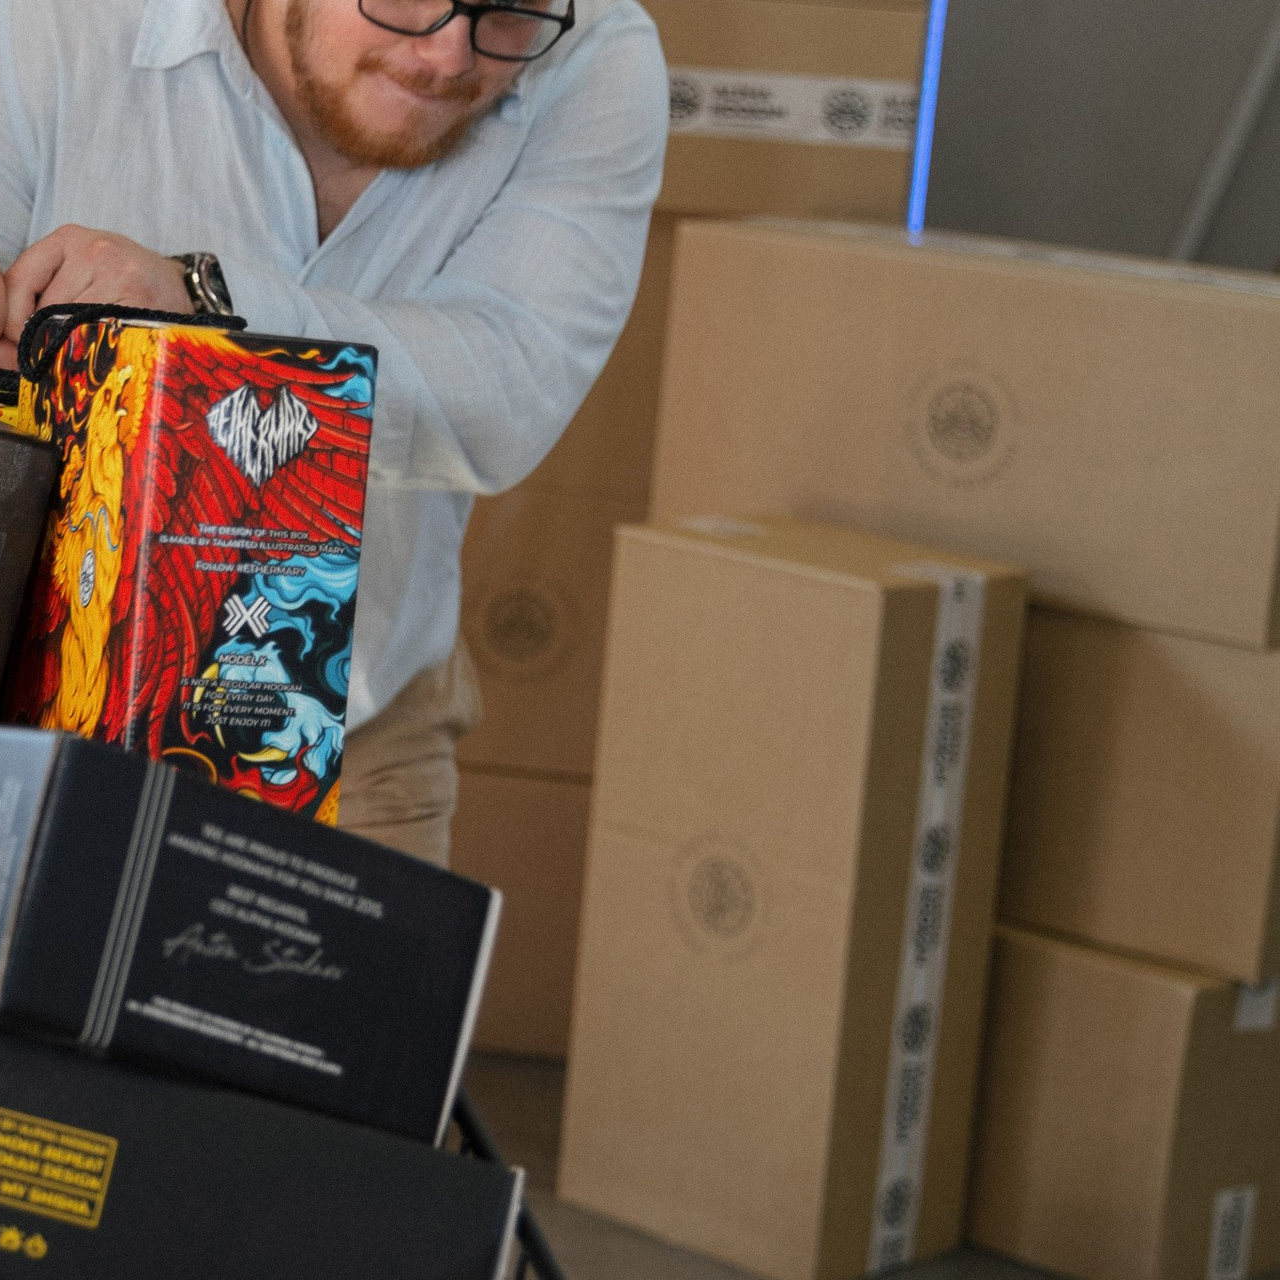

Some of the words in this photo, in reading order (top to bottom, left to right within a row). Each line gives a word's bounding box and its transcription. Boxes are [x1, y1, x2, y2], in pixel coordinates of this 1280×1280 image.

[199, 523, 218, 533] THE
[220, 526, 253, 536] DESIGN
[255, 528, 267, 537] OF
[270, 530, 289, 539] THIS
[291, 531, 310, 540] BOX
[169, 535, 197, 545] MADE
[260, 541, 317, 552] ILLUSTRATOR
[320, 542, 345, 554] MARY
[195, 560, 234, 572] FOLLOW
[220, 654, 257, 665] MODEL
[260, 656, 268, 665] X
[191, 679, 209, 687] NOT
[220, 681, 261, 690] REGULAR
[264, 683, 302, 692] HOOKAH
[205, 691, 223, 700] FOR
[226, 693, 255, 702] EVERY
[224, 706, 252, 715] EVERY
[206, 716, 228, 725] JUST
[230, 718, 260, 727] ENJOY
